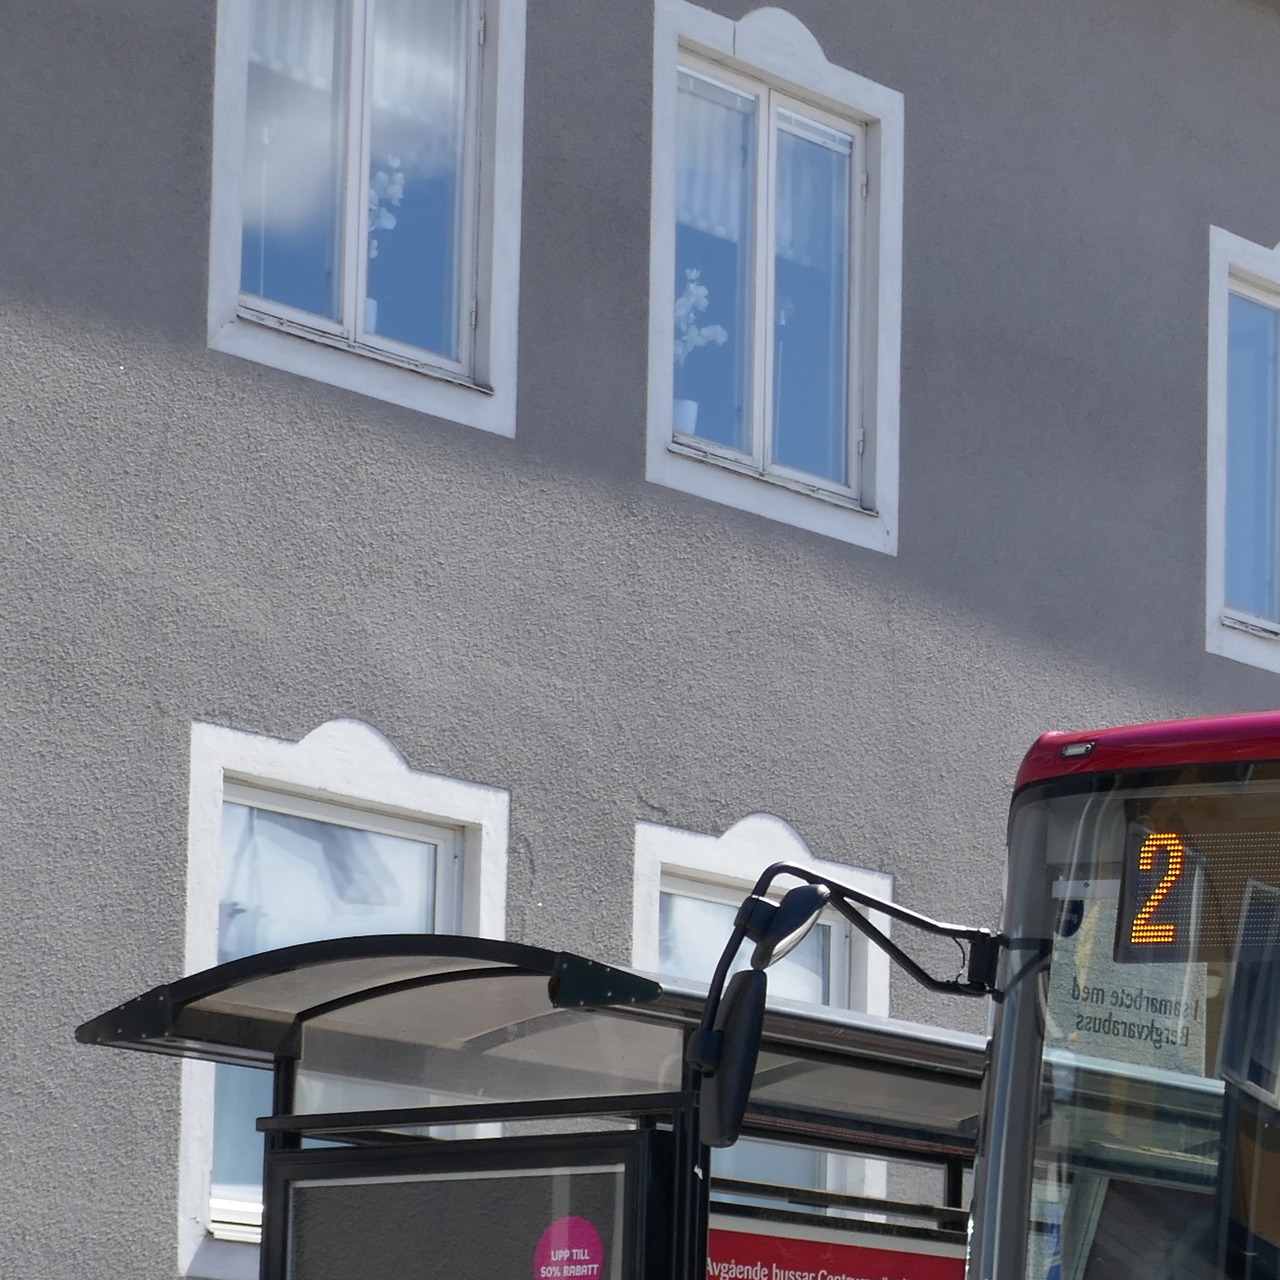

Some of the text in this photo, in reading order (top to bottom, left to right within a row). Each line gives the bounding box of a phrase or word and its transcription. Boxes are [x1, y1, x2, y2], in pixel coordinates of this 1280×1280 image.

[1131, 832, 1185, 944] 2
[550, 1248, 590, 1261] UPP TILL
[540, 1264, 599, 1278] 50% RABATT
